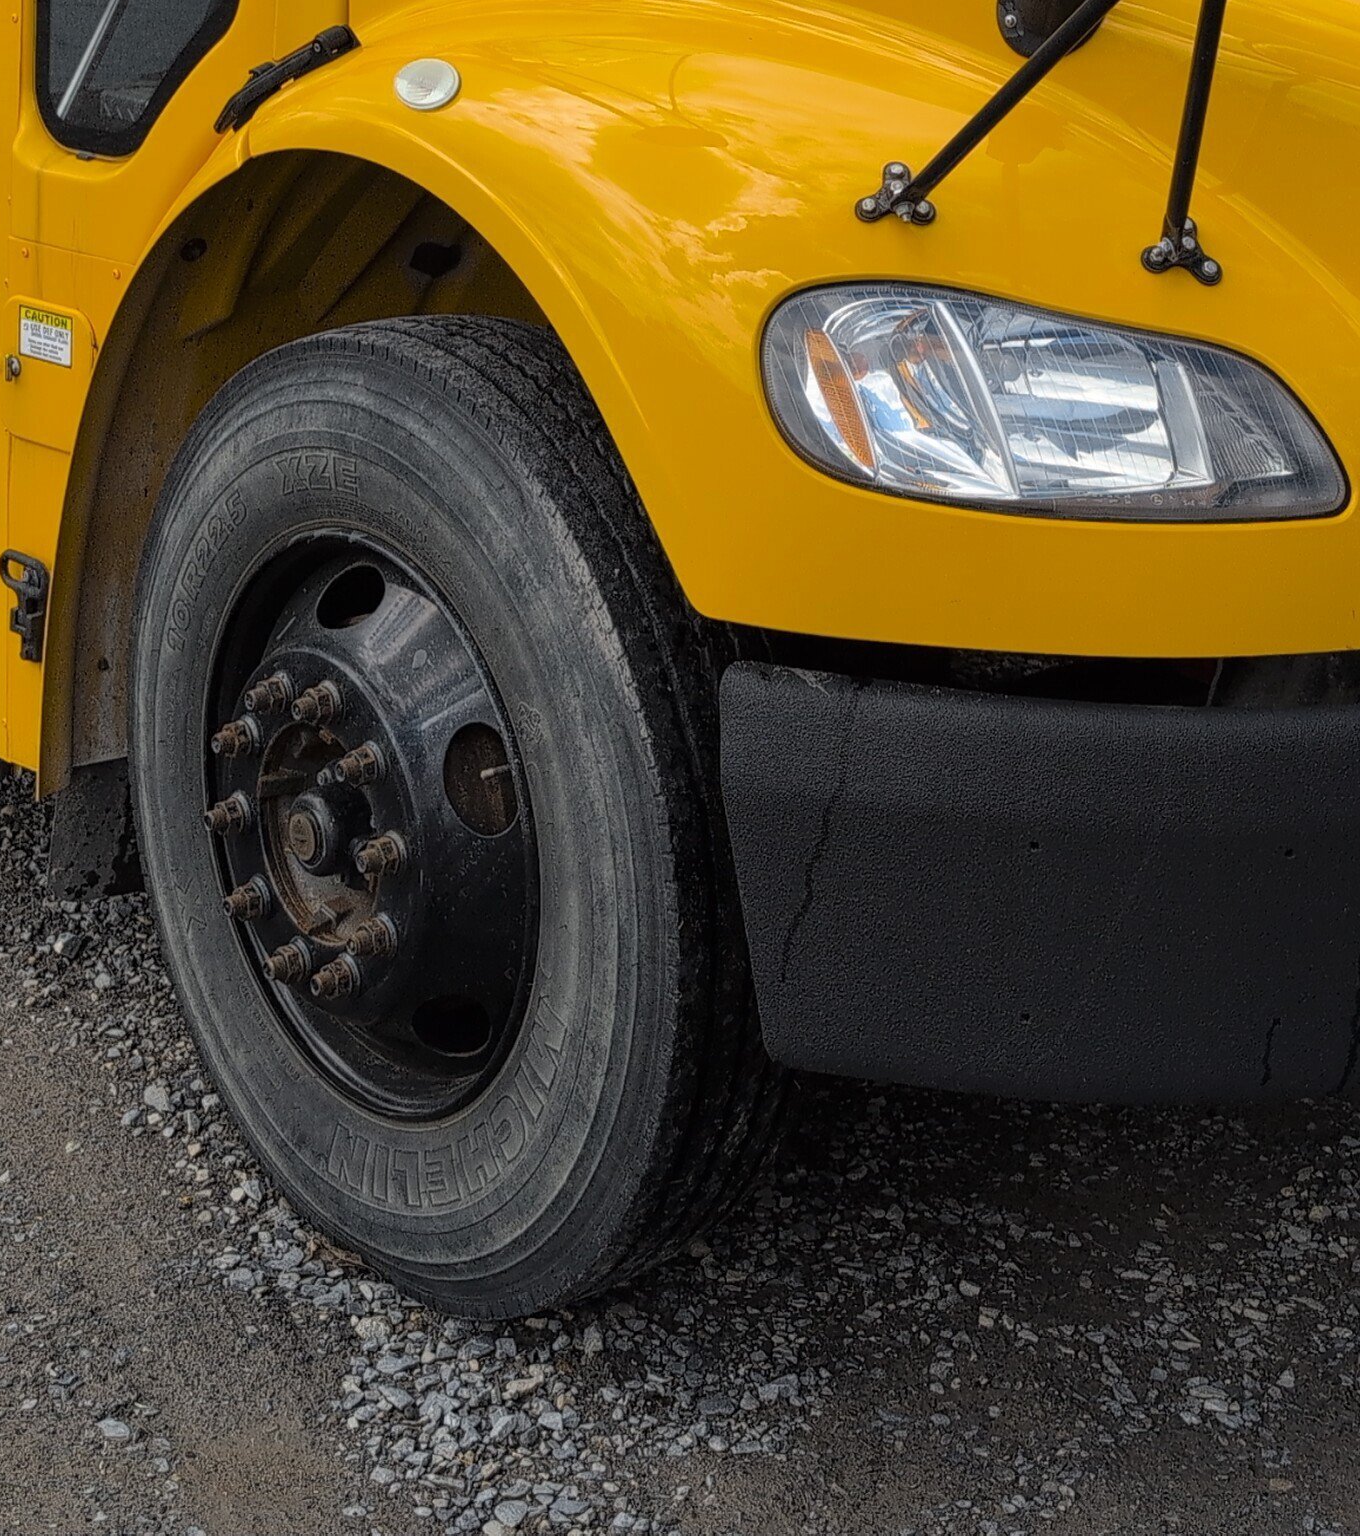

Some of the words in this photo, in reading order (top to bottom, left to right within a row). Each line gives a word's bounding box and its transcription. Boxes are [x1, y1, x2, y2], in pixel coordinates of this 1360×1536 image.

[24, 310, 68, 329] CAUTION
[275, 452, 361, 498] XZE
[167, 486, 248, 653] 10R22.5
[327, 994, 569, 1209] MICHELIN
